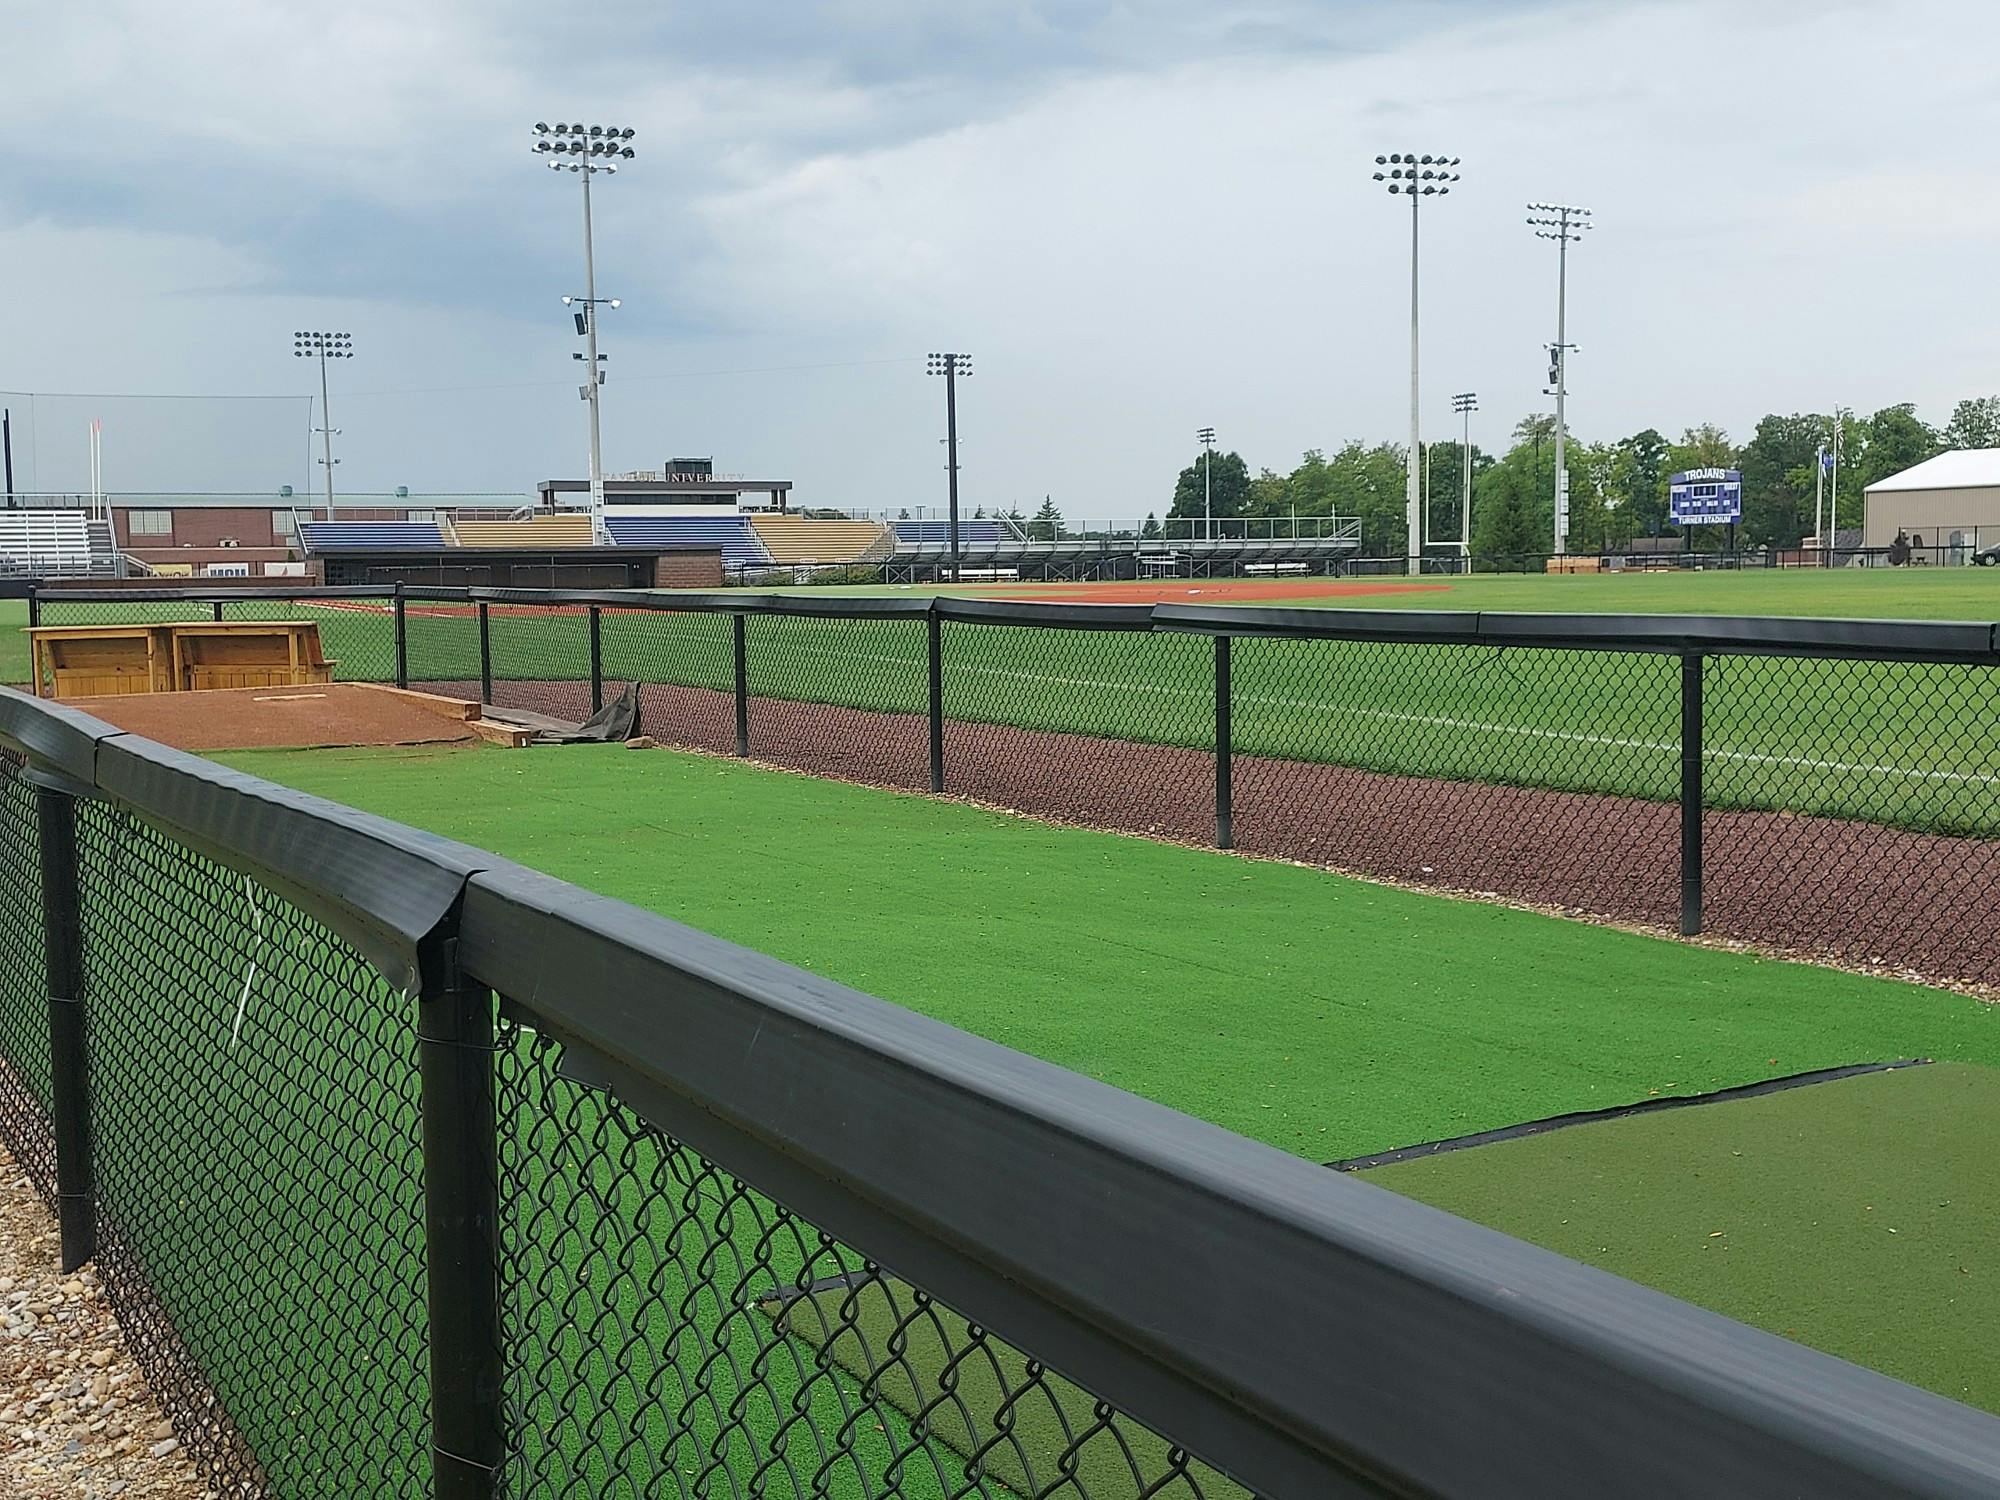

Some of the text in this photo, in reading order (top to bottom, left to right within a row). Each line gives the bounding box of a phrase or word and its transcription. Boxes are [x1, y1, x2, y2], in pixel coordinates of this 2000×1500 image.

[660, 472, 745, 483] UNIVERSITY
[1684, 468, 1725, 481] TROJANS
[1703, 515, 1731, 524] STADIUM
